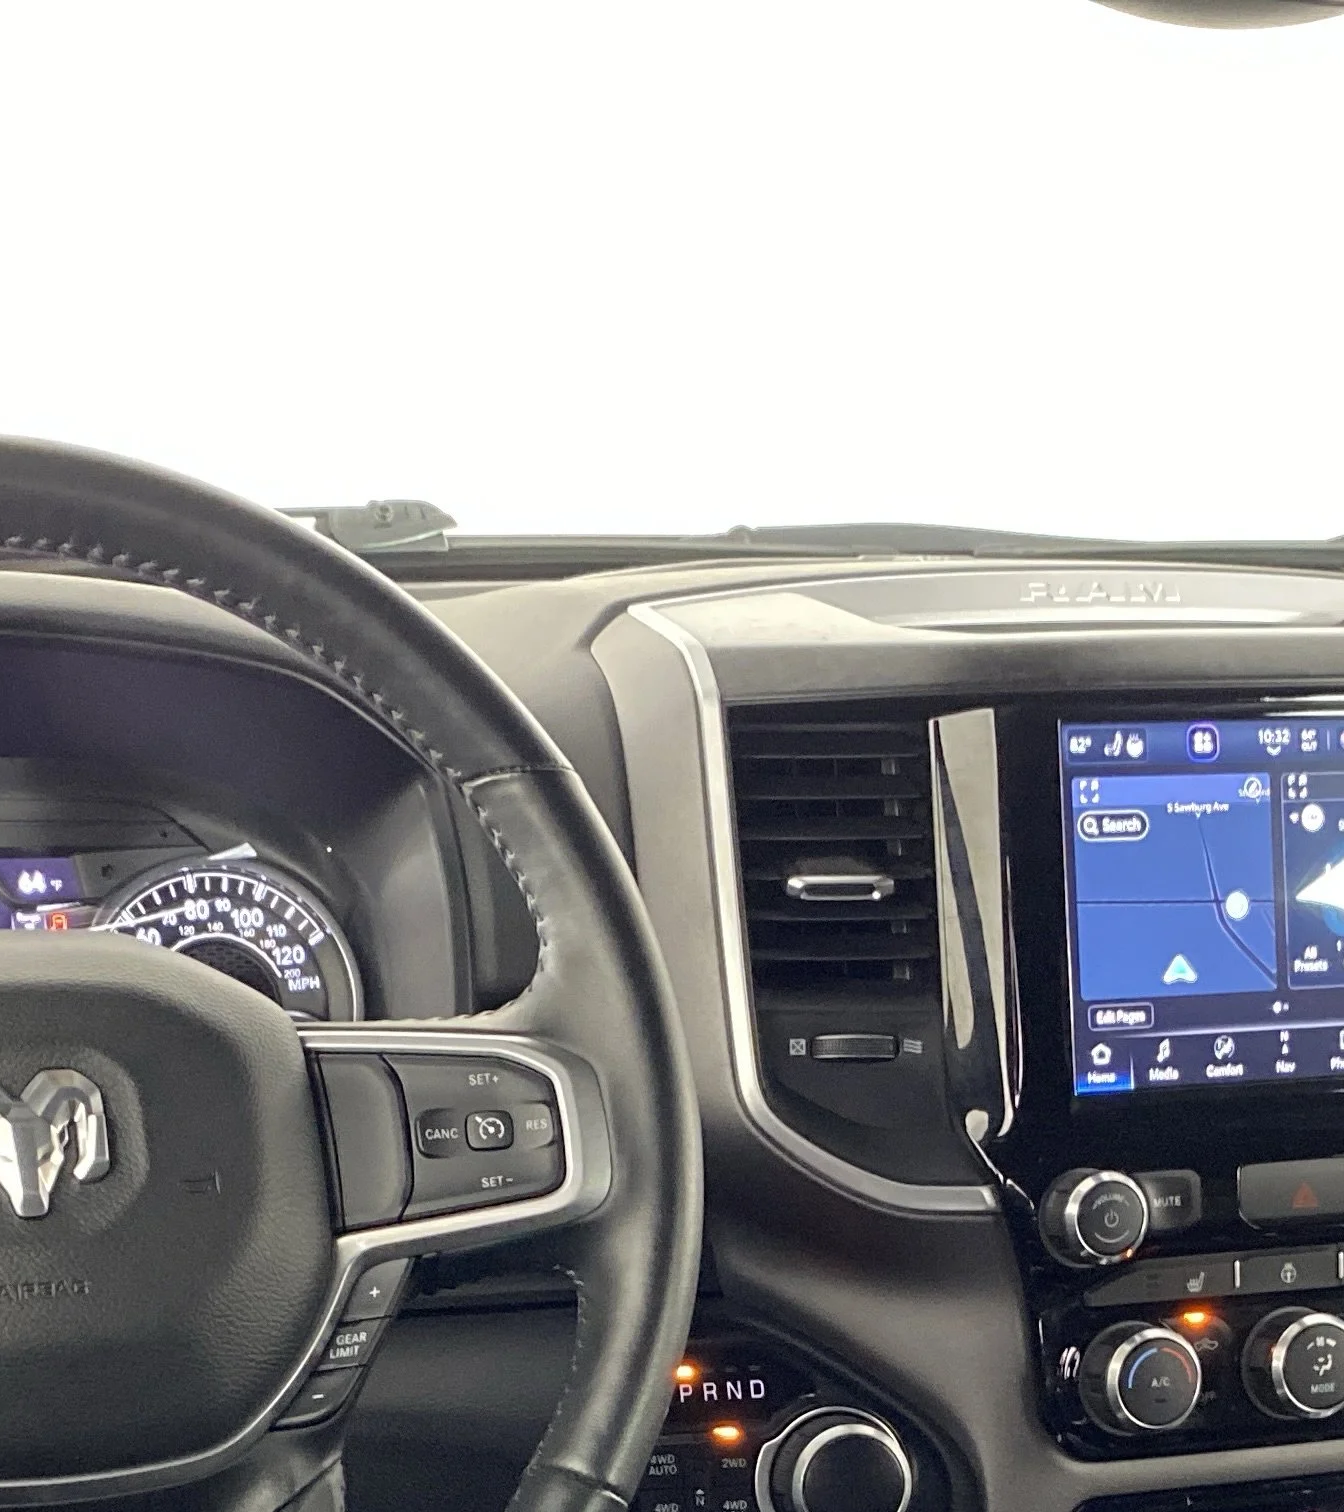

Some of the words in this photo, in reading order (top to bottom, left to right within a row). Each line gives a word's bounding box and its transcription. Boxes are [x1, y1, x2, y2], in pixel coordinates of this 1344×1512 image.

[1258, 728, 1291, 745] 10:32
[1102, 817, 1141, 833] Search
[230, 907, 264, 928] 100
[178, 925, 195, 936] 120
[266, 924, 287, 938] 110
[272, 945, 306, 966] 120
[283, 968, 301, 979] 200
[288, 976, 320, 991] MPH
[1206, 1063, 1244, 1078] Comfort
[1275, 1059, 1296, 1073] Nav
[1087, 1072, 1116, 1084] Home
[1149, 1067, 1179, 1081] Media
[525, 1118, 548, 1131] RES
[425, 1127, 459, 1141] CANC
[1154, 1195, 1182, 1208] MUTE
[335, 1331, 367, 1346] GEAR
[329, 1345, 361, 1360] LIMIT
[1151, 1376, 1171, 1388] A/C
[1310, 1383, 1336, 1394] MODE
[650, 1454, 676, 1466] 4WD
[721, 1457, 747, 1469] 2WD
[648, 1464, 678, 1476] AUTO
[655, 1503, 679, 1512] 4WD
[695, 1496, 705, 1507] N
[722, 1500, 748, 1511] 4WD
